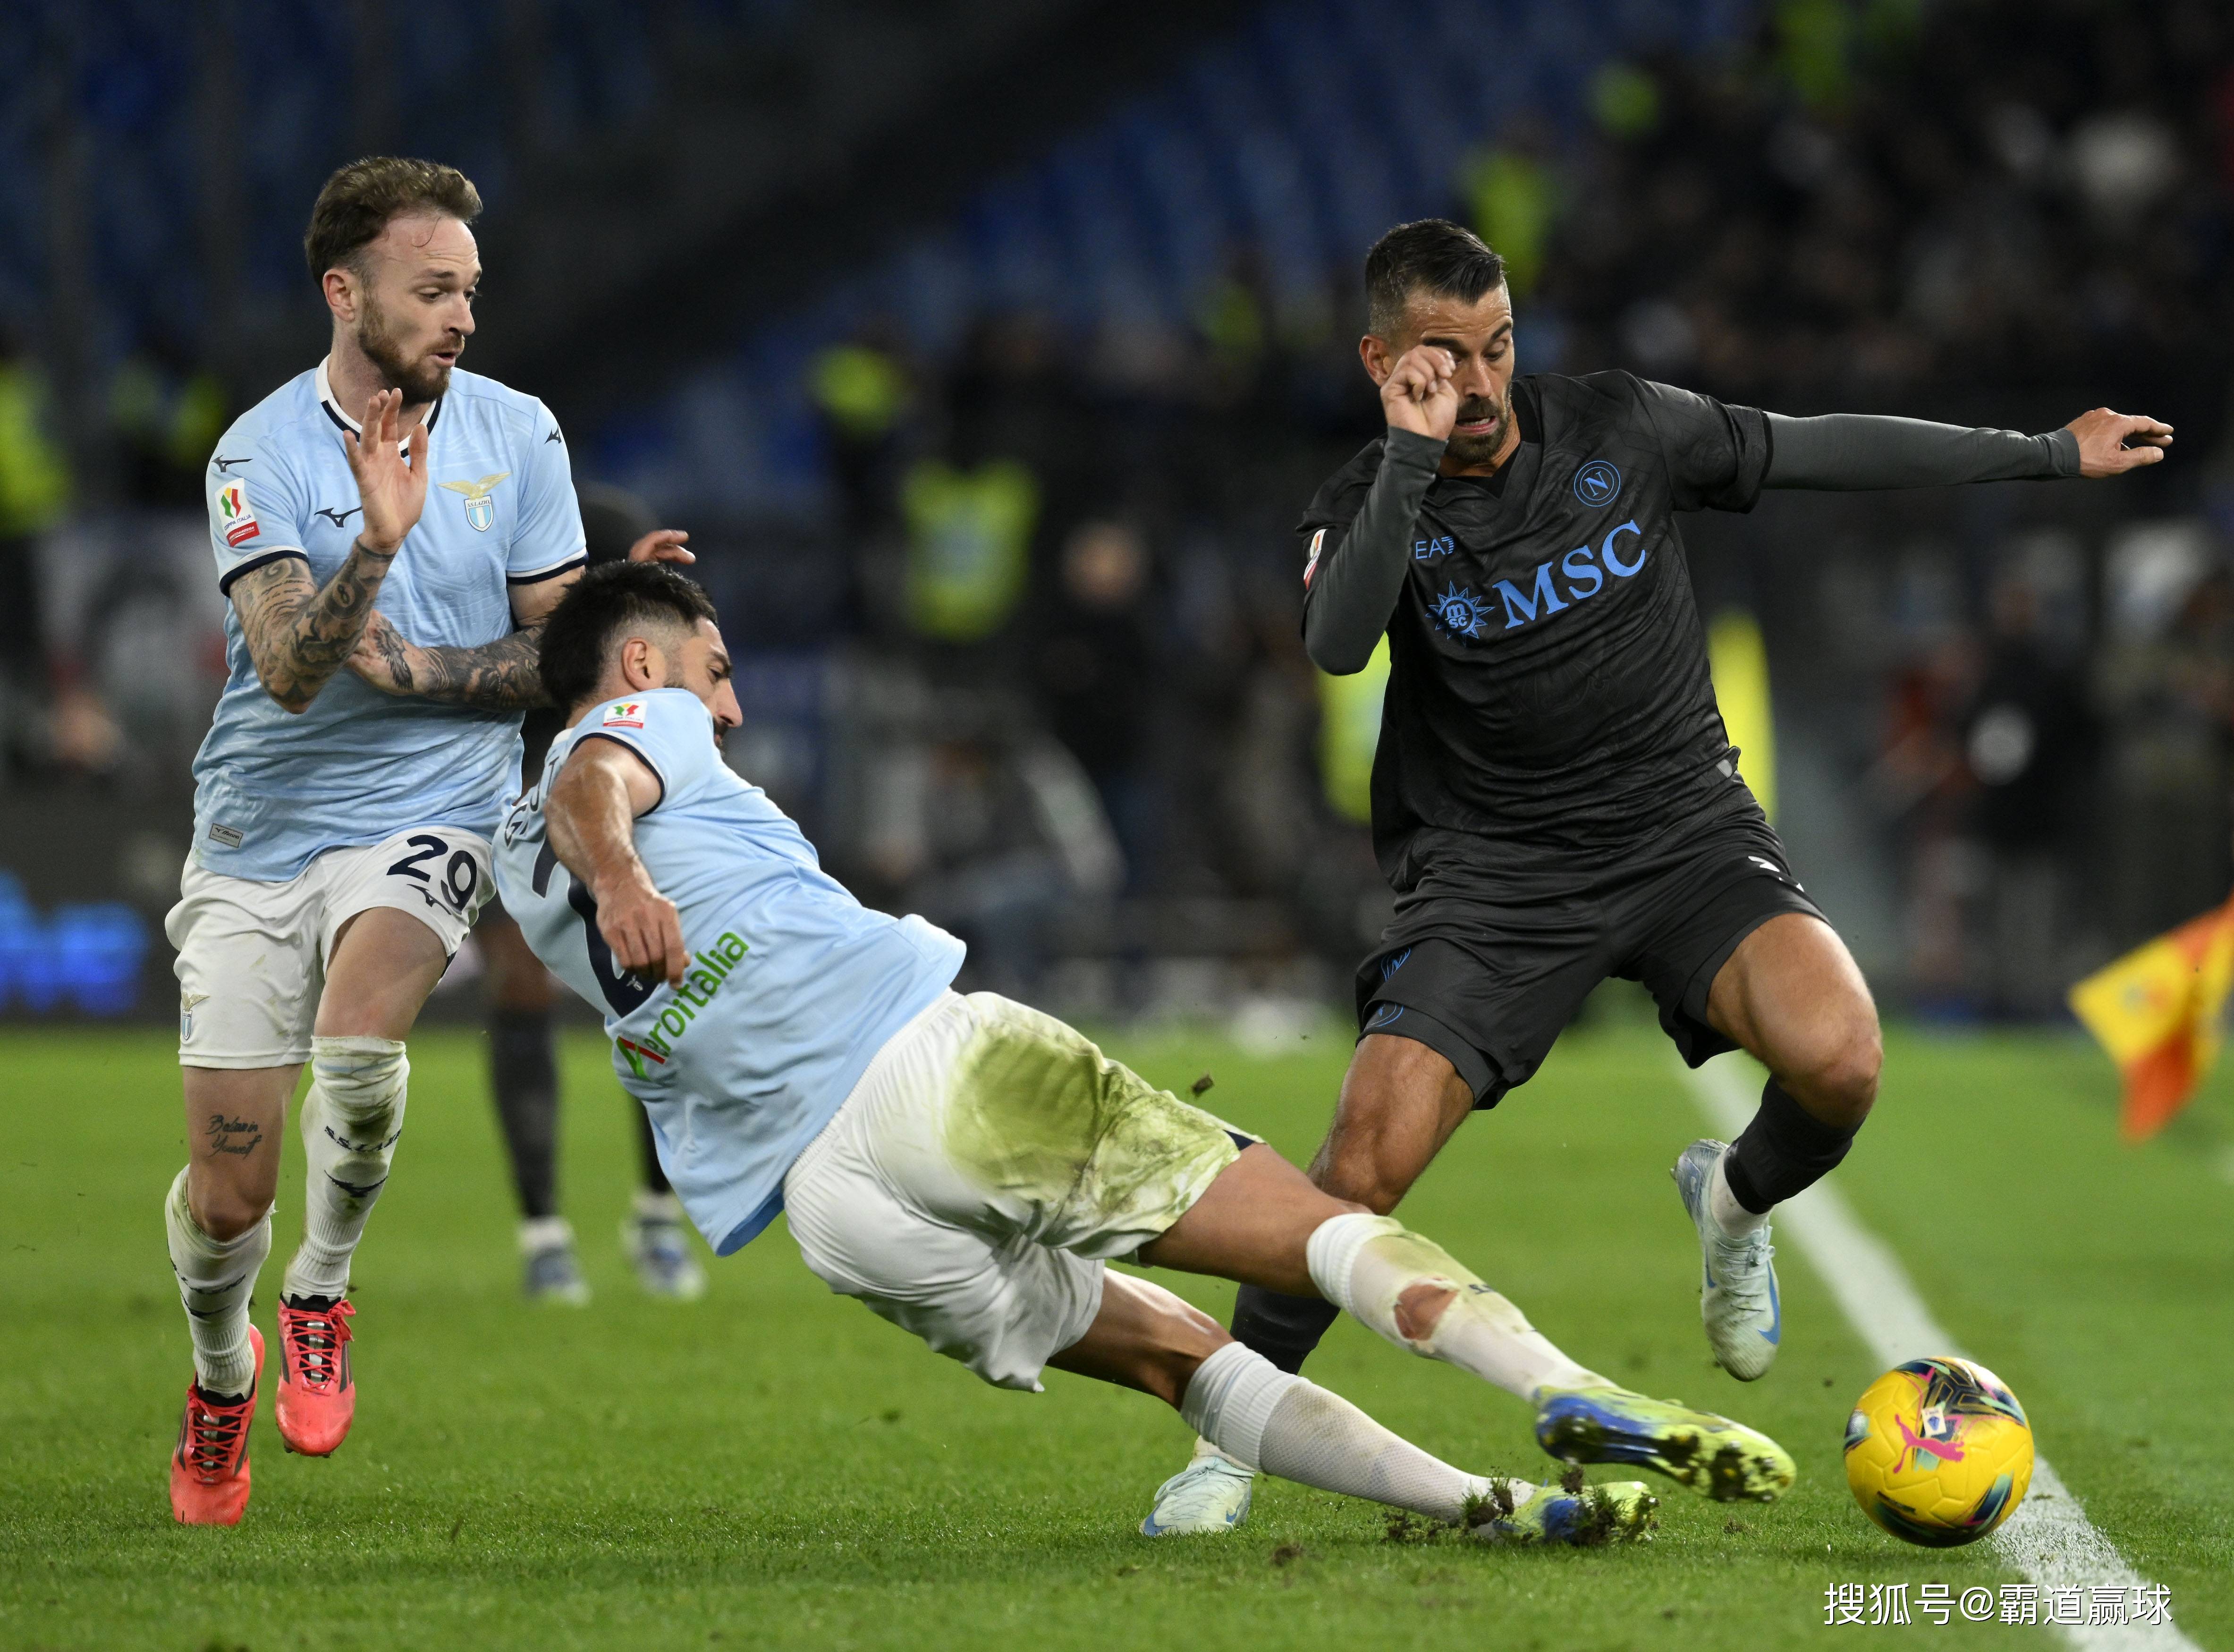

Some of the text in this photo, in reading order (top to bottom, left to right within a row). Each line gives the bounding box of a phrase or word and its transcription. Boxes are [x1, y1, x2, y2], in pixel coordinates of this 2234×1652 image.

[1584, 471, 1608, 497] N
[237, 514, 252, 523] ITALIA
[1416, 536, 1454, 560] EA7
[1492, 520, 1645, 629] MSC
[386, 835, 477, 915] 29
[616, 932, 749, 1081] Aeroitalia
